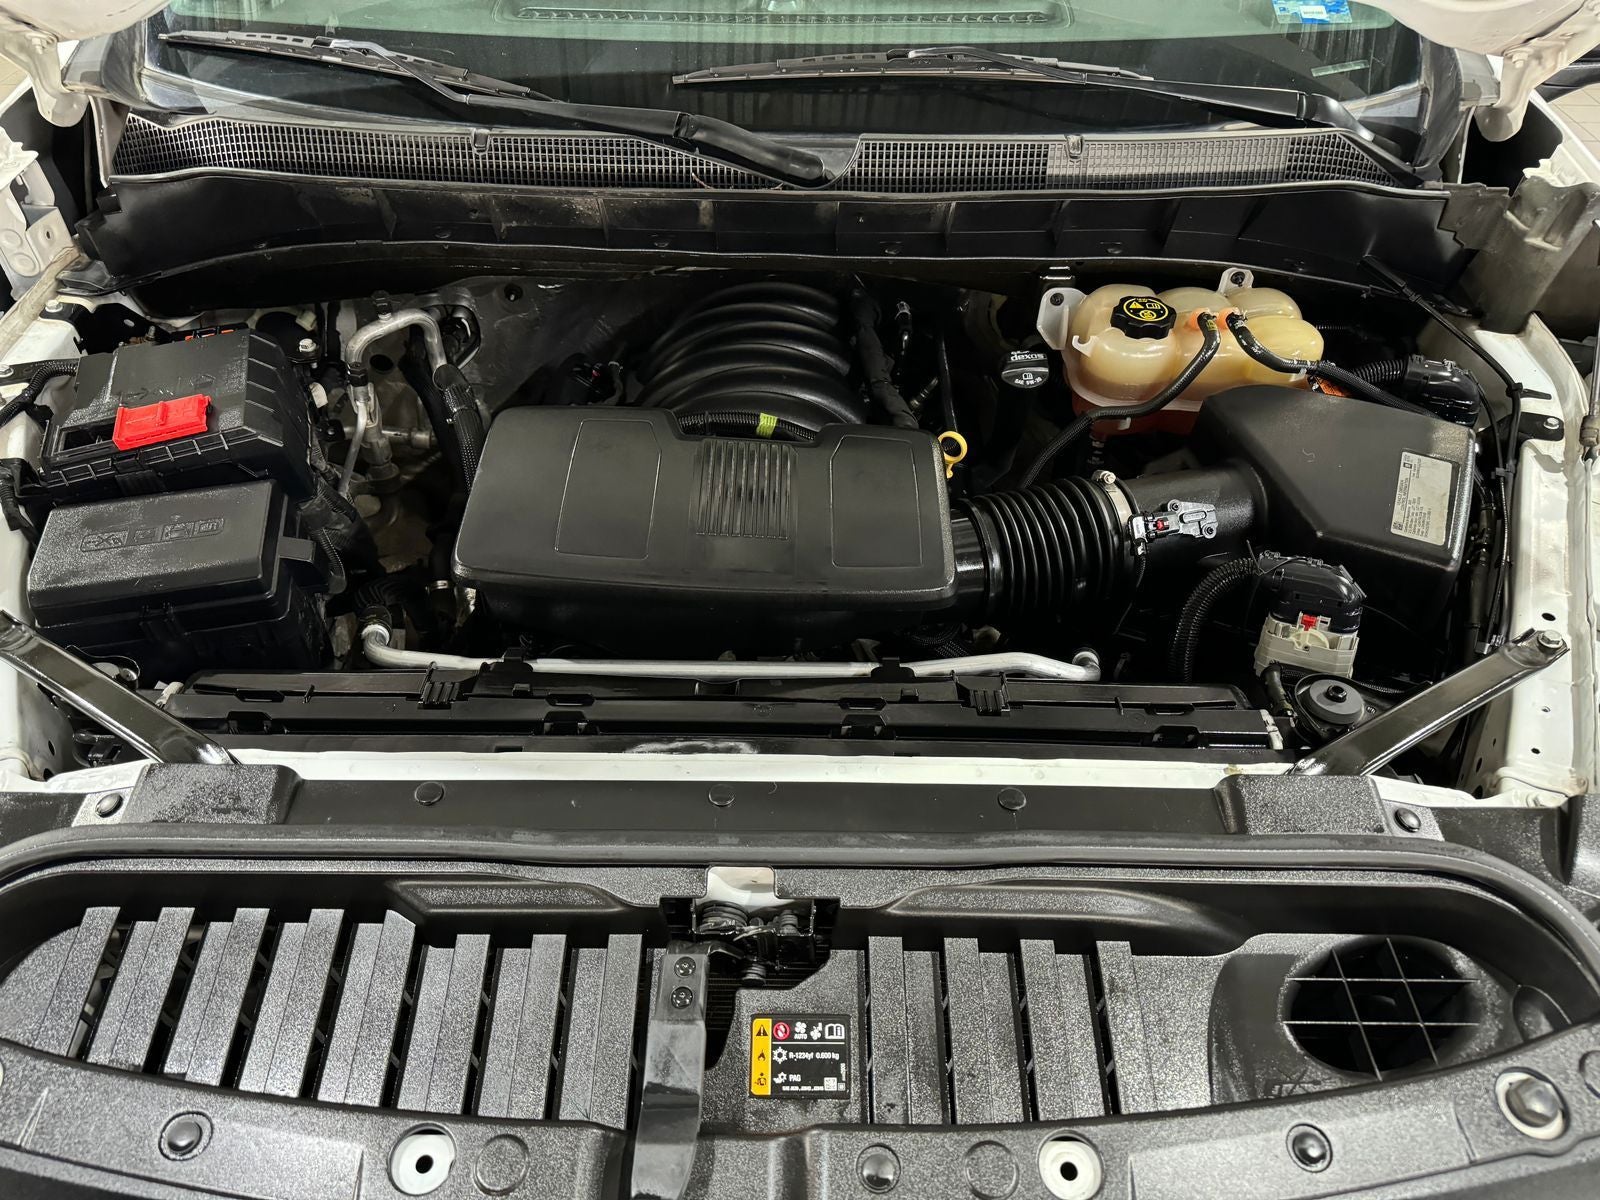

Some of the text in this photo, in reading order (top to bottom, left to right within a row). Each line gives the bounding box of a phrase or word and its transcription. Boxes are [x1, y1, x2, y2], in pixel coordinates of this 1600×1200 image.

[1010, 353, 1044, 361] dexos
[789, 1052, 813, 1060] R-1234yf
[832, 1052, 840, 1060] kg
[789, 1074, 801, 1082] PAG
